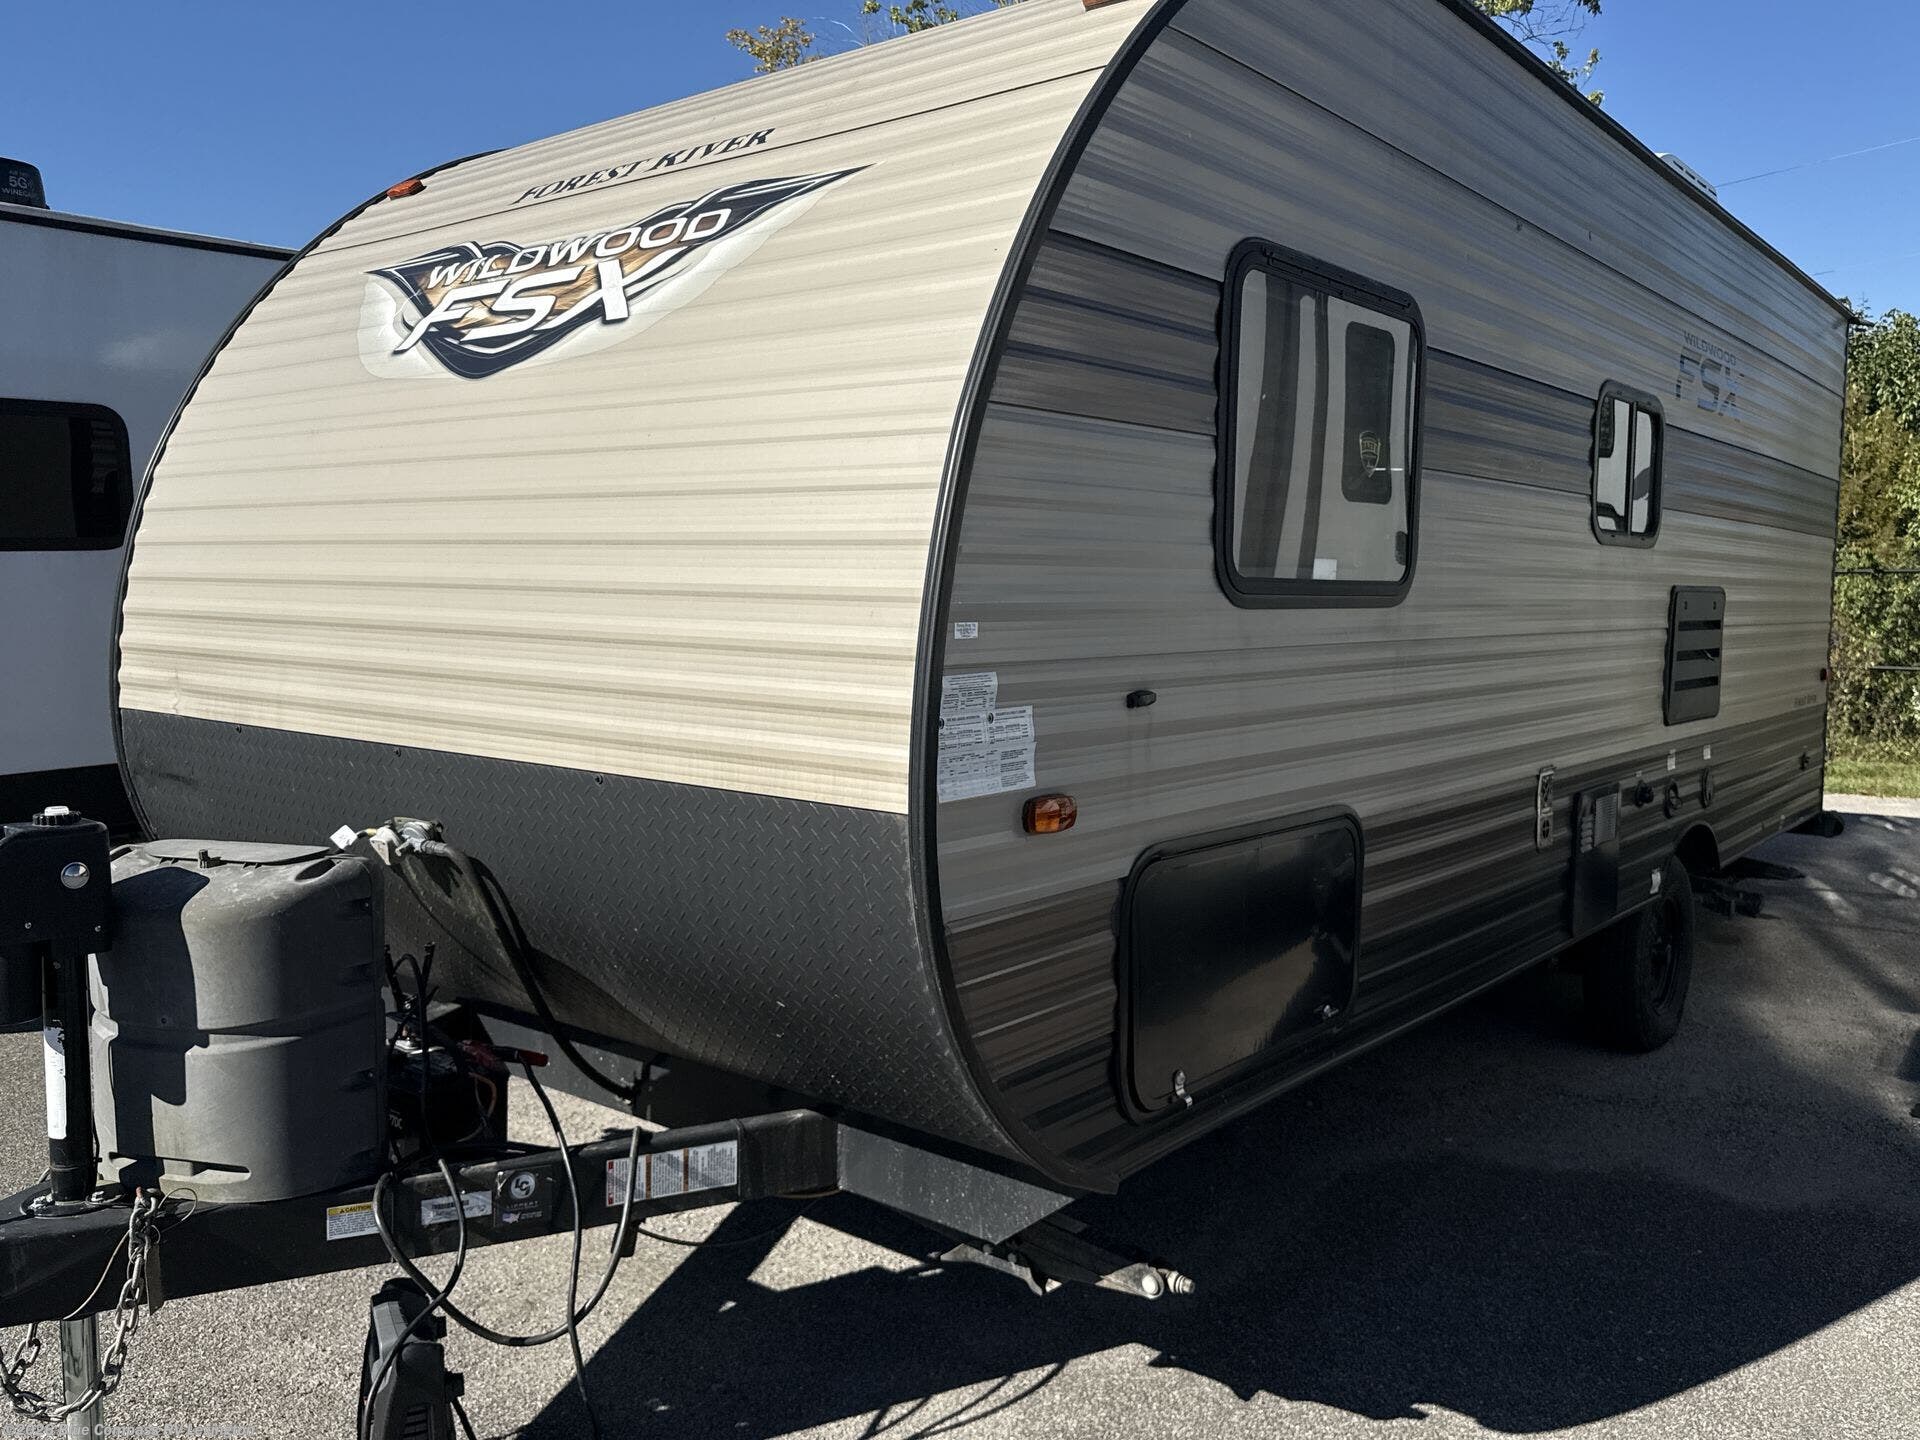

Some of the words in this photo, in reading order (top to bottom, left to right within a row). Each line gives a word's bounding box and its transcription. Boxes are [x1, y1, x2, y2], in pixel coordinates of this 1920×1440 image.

[513, 158, 651, 204] FOREST
[643, 128, 776, 172] RIVER
[426, 208, 732, 290] WILDWOOD
[393, 245, 688, 354] FSX
